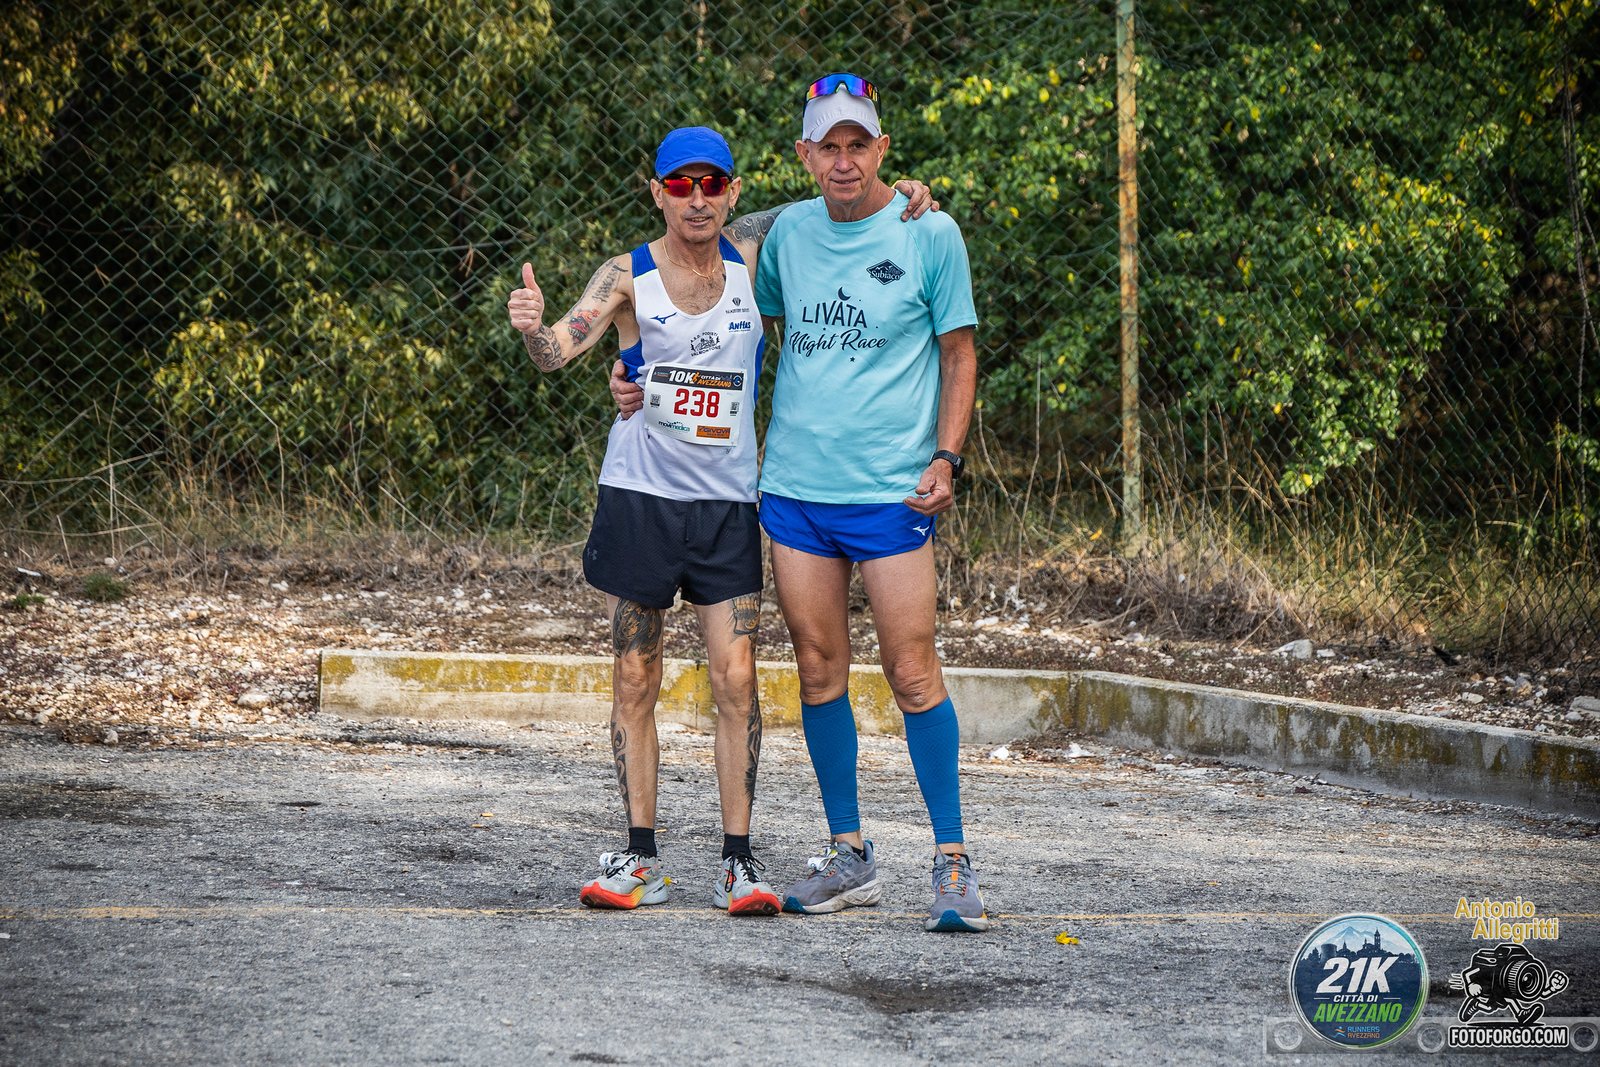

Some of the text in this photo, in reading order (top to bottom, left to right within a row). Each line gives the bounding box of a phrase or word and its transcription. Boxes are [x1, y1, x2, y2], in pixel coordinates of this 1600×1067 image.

[871, 270, 901, 280] Subiaco
[802, 300, 867, 328] LIVATA
[789, 329, 888, 357] Night Race
[669, 370, 695, 384] 10K
[673, 388, 720, 418] 238
